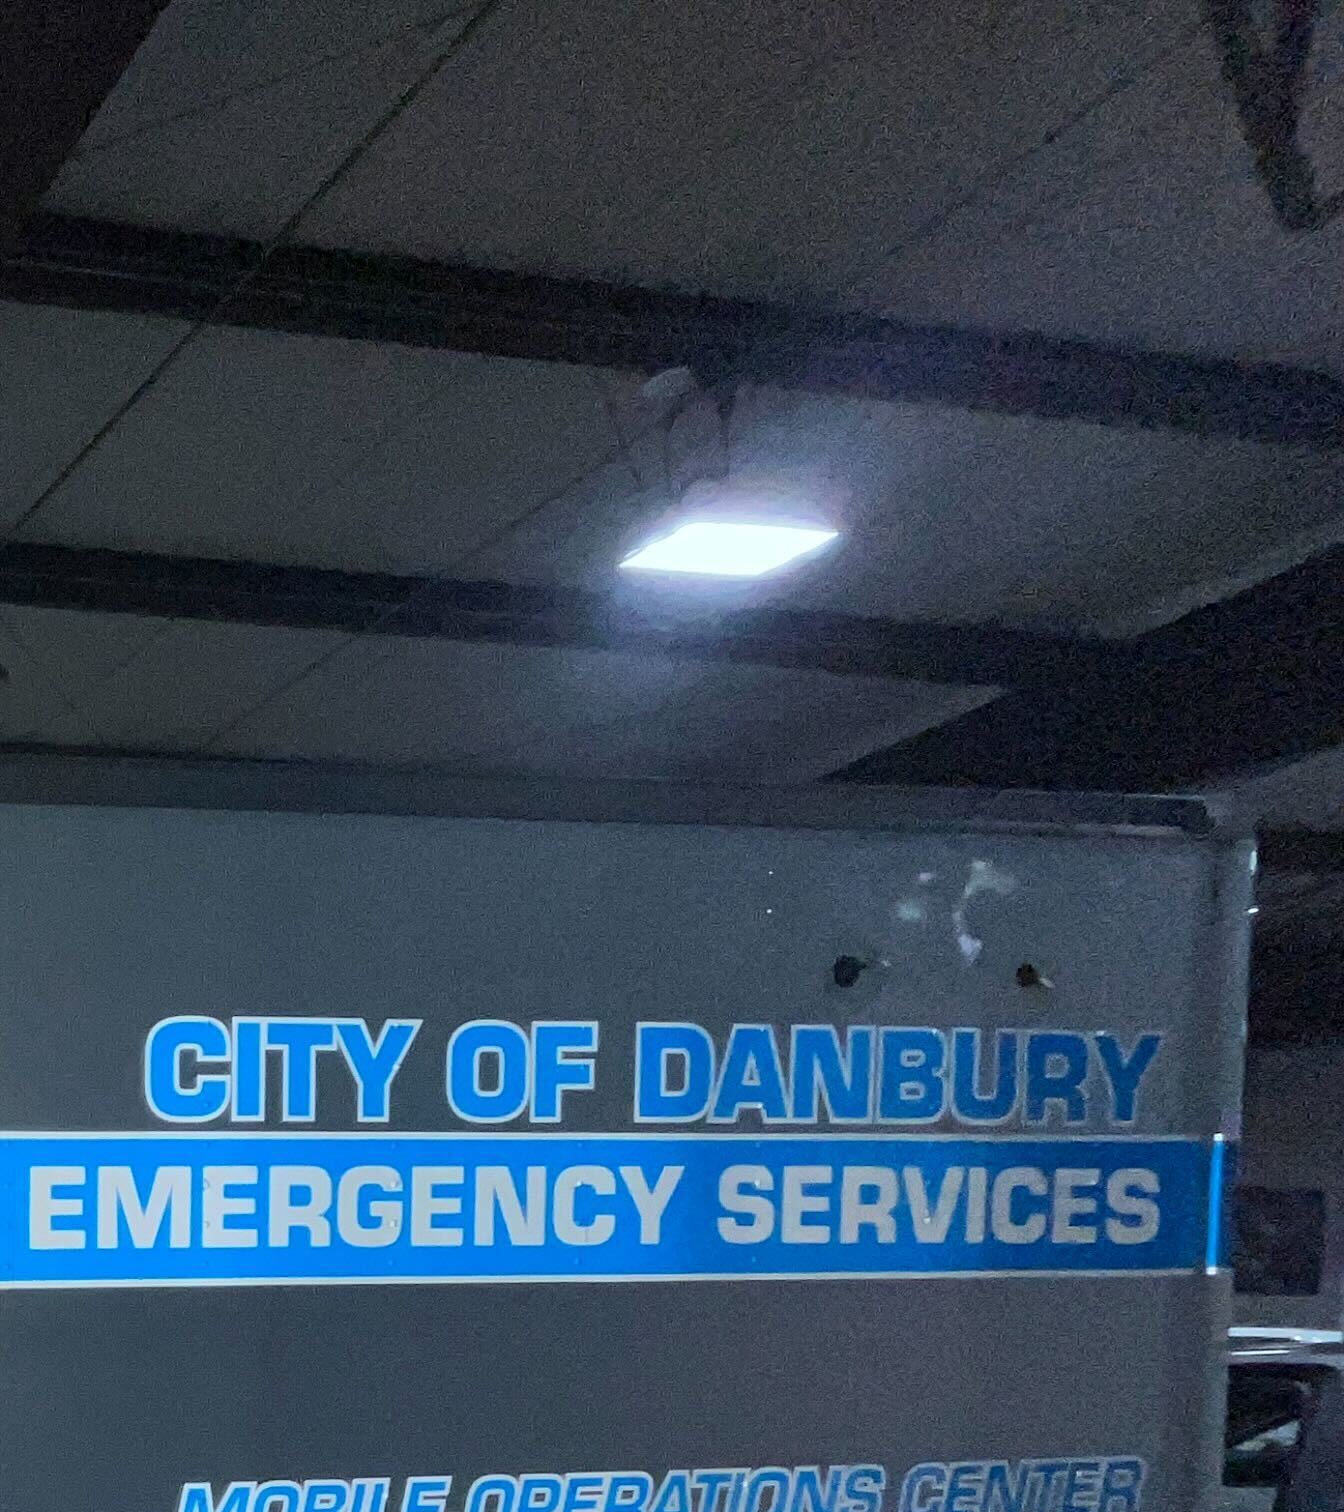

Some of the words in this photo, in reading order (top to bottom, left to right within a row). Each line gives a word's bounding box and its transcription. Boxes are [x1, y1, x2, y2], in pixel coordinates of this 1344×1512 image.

[144, 1016, 422, 1125] CITY
[446, 1017, 600, 1125] OF
[633, 1021, 1162, 1126] DANBURY
[29, 1165, 686, 1251] EMERGENCY
[717, 1164, 1162, 1245] SERVICES
